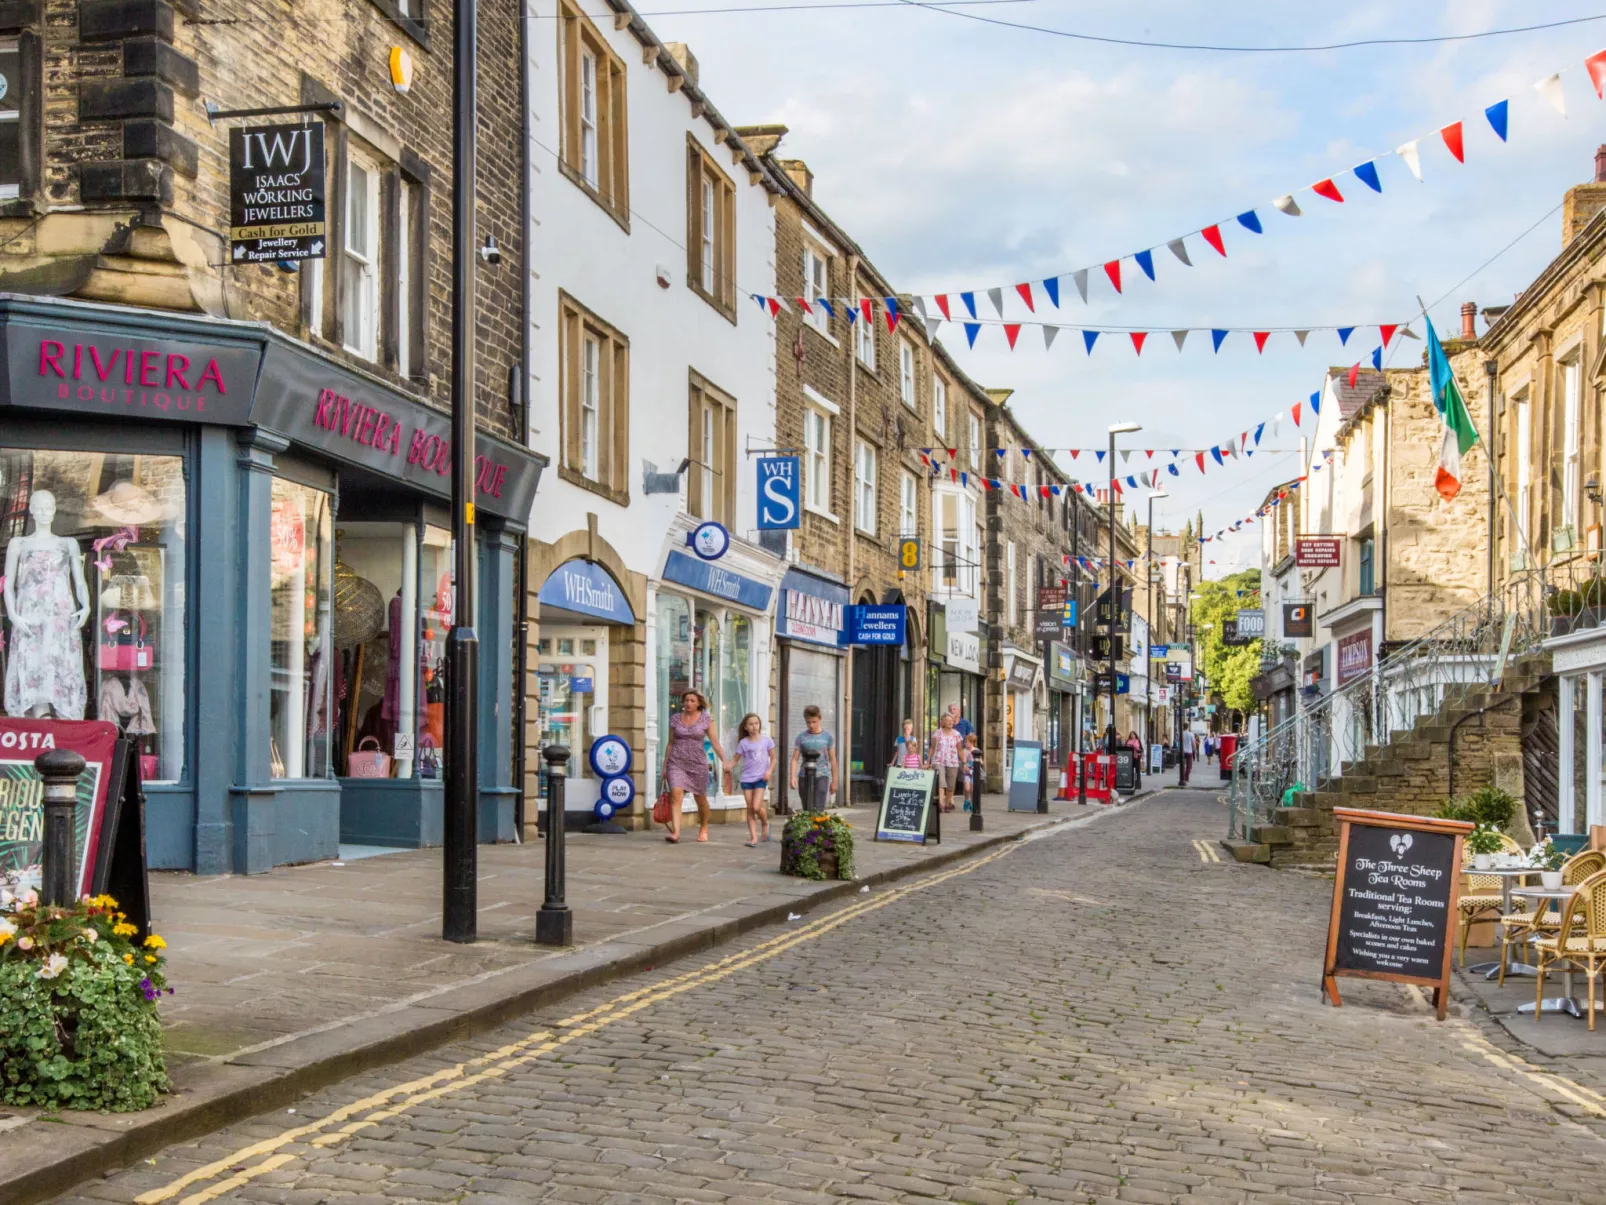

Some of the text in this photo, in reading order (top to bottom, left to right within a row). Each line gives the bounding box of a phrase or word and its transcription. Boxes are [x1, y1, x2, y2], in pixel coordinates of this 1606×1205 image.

[242, 130, 313, 175] IWJ
[255, 173, 301, 188] ISAACS
[243, 189, 313, 205] WORKING
[244, 205, 314, 224] JEWELLERS
[238, 224, 317, 239] Cash for Gold
[258, 238, 298, 250] Jewellery
[248, 248, 309, 261] Repair Service
[39, 339, 228, 394] RIVIERA
[58, 383, 206, 412] BOUTIQUE
[315, 387, 508, 498] RIVIERA BOUQUE
[763, 462, 793, 476] WH
[763, 476, 795, 524] S
[707, 566, 741, 599] WHSmith
[564, 571, 614, 612] WHSmith
[854, 605, 899, 620] Hannams
[856, 619, 896, 630] Jewellers
[1238, 616, 1264, 632] FOOD
[858, 632, 896, 640] CASH FOR GOLD
[0, 731, 55, 750] OSTA
[1355, 858, 1442, 880] The Three Sheep
[1368, 872, 1426, 889] Tea Rooms
[1349, 888, 1445, 908] Traditional Tea Rooms
[1378, 902, 1412, 914] serving:
[1354, 911, 1434, 928] Breakfasts, Light Lunches,
[1369, 921, 1417, 932] Afternoon Teas
[1349, 929, 1380, 941] Specialists
[1416, 937, 1436, 947] baked
[1365, 940, 1386, 948] scones
[1399, 944, 1417, 952] cakes
[1352, 947, 1378, 959] Wishing
[1376, 959, 1403, 968] welcome
